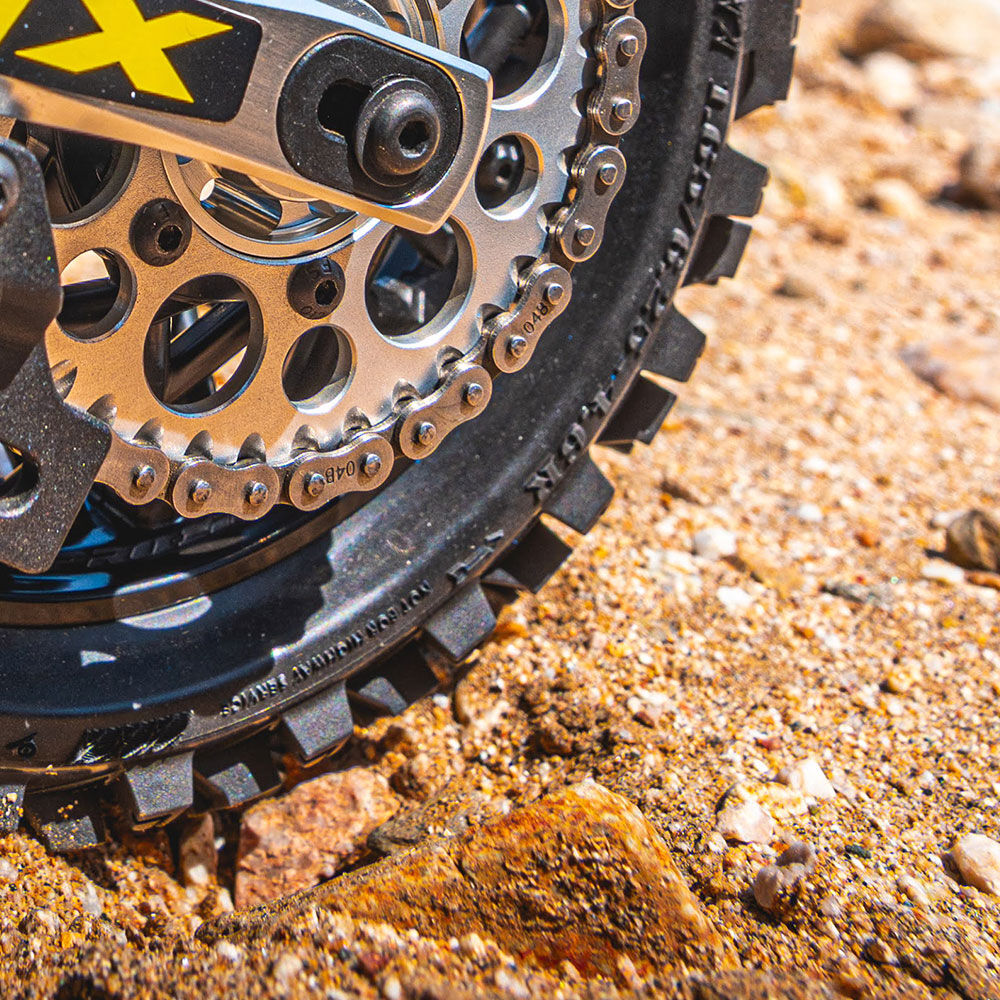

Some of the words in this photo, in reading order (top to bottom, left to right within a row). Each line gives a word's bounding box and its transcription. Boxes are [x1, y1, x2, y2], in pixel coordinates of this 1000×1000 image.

[325, 460, 356, 484] 04B
[401, 579, 434, 614] NOT
[365, 606, 399, 637] FOR
[291, 629, 365, 681] HIGHWAY
